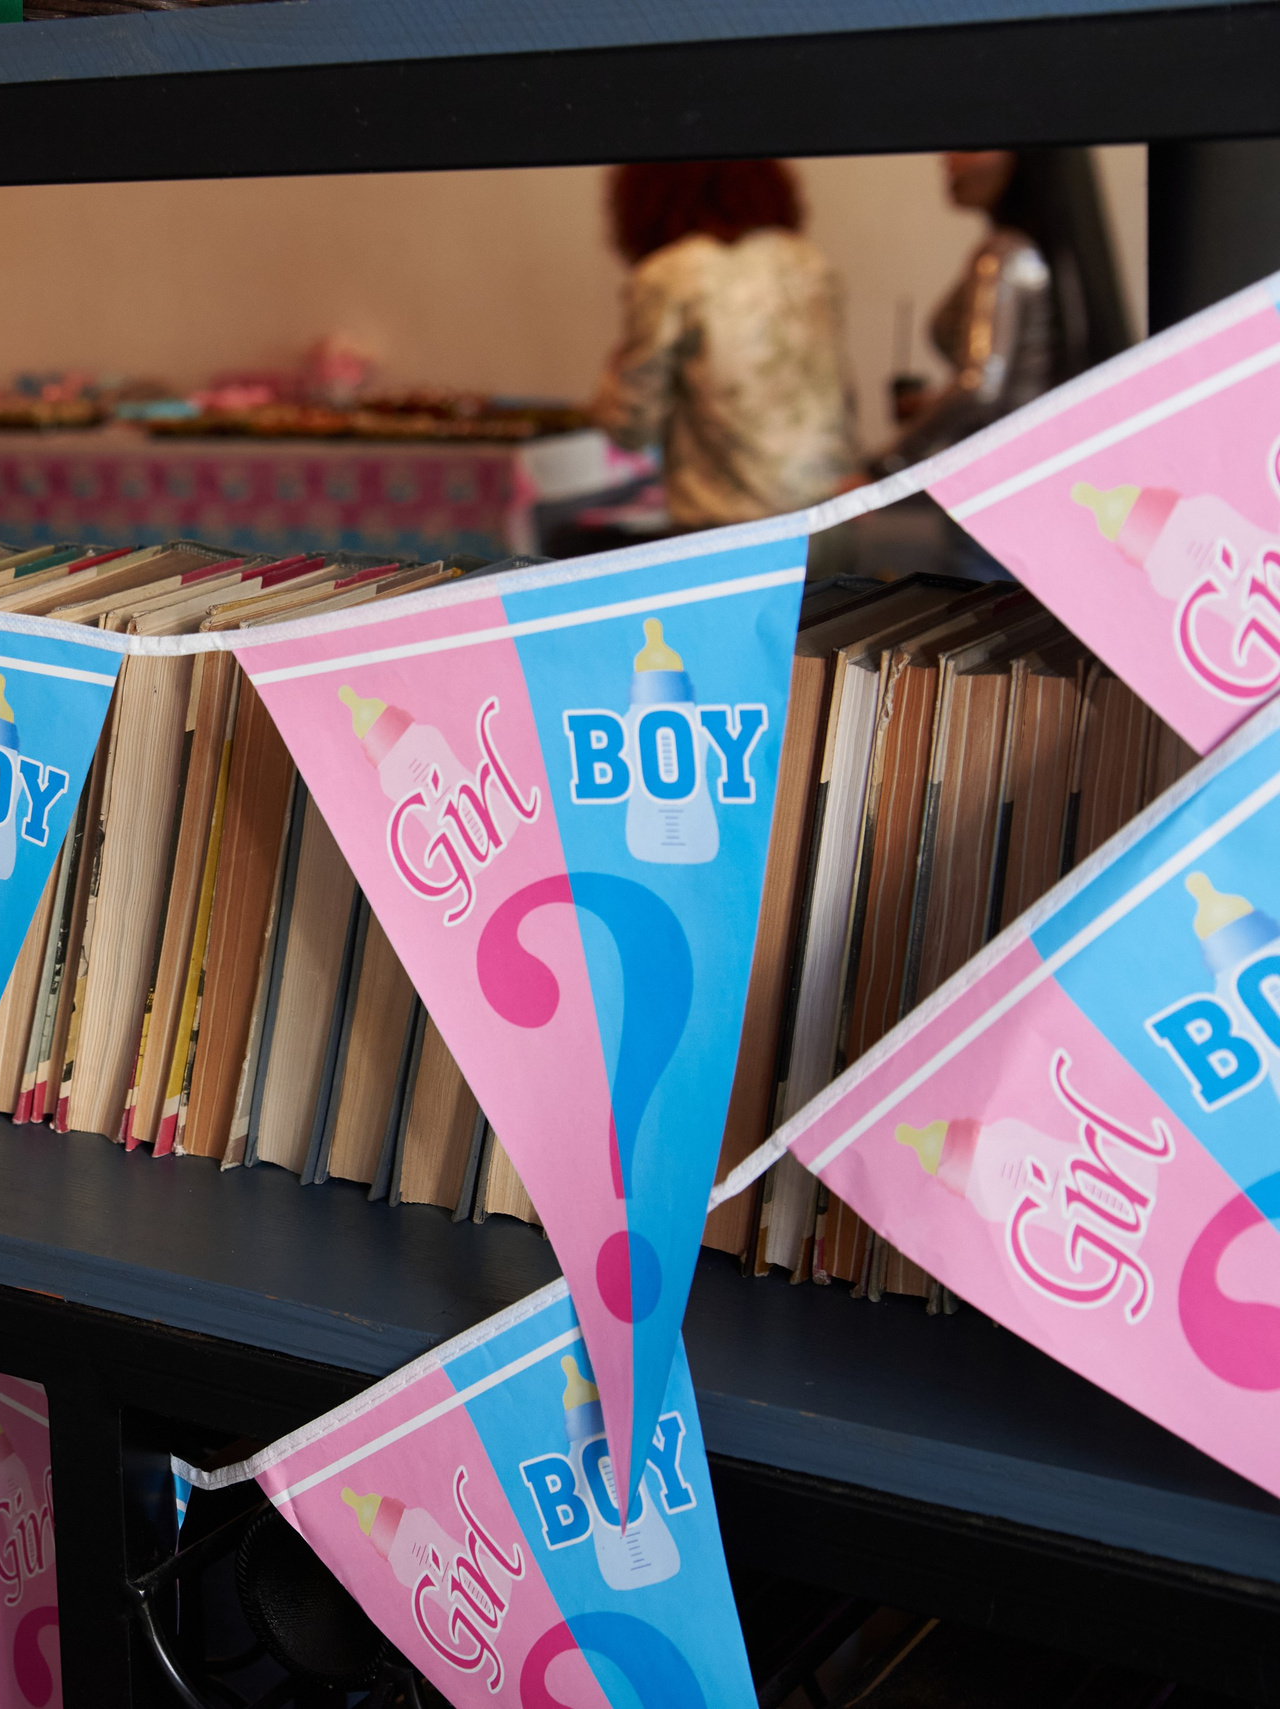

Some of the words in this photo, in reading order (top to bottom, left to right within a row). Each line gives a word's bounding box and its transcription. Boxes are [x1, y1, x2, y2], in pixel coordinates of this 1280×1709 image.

[386, 695, 541, 927] Girl
[563, 703, 768, 805] BOY
[1004, 1047, 1176, 1325] Girl
[410, 1465, 525, 1695] Girl
